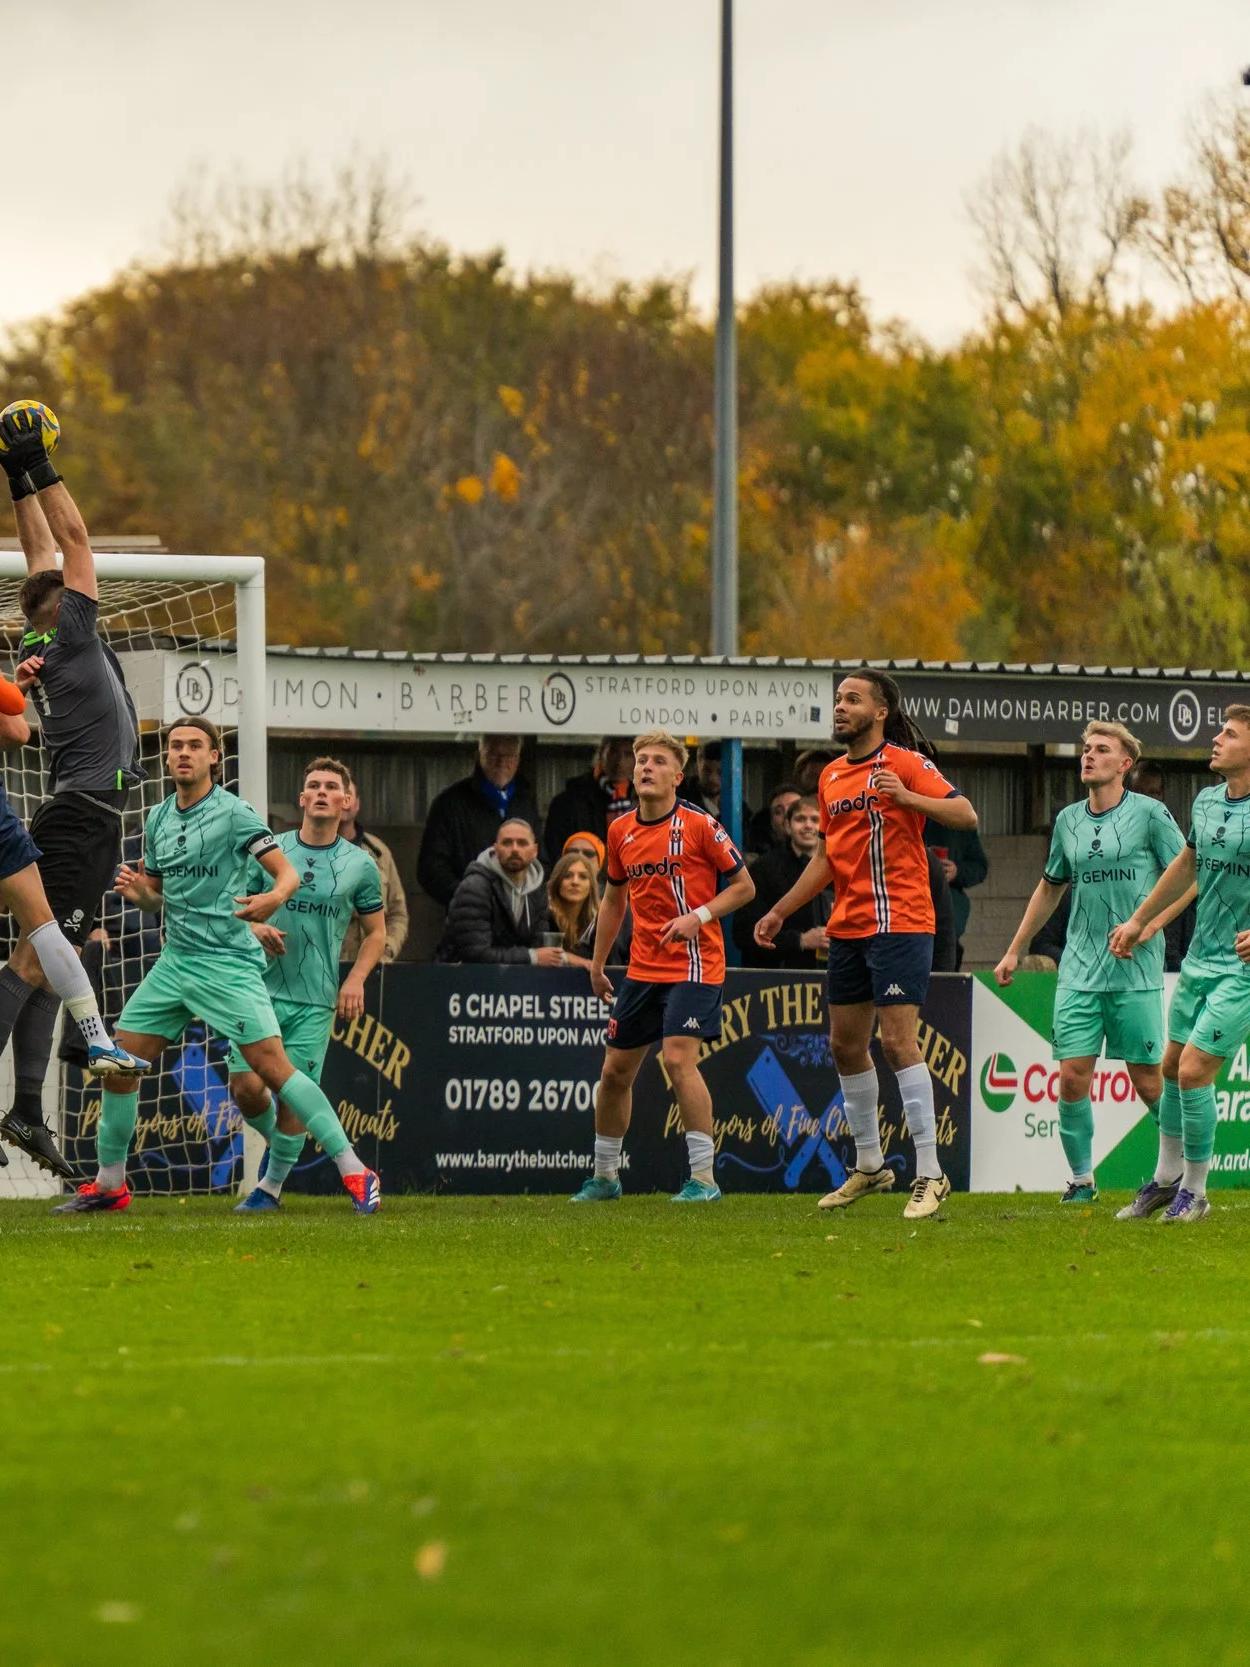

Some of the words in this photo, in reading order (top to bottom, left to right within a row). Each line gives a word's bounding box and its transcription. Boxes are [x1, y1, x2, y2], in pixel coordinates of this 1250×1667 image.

[224, 677, 358, 710] DIMON
[401, 682, 533, 713] BARBER
[585, 676, 695, 695] STRATFORD
[706, 679, 759, 697] UPON
[768, 680, 819, 699] AVON
[619, 708, 699, 725] LONDON
[729, 709, 784, 727] PARIS
[903, 697, 1159, 724] WW.DAIMONBARBER.COM
[168, 865, 218, 878] GEMINI
[1082, 868, 1136, 884] GEMINI
[286, 898, 340, 918] GEMINI
[448, 993, 461, 1017] 6
[466, 993, 545, 1019] CHAPEL
[760, 982, 823, 1031] THE
[449, 1026, 534, 1045] STRATFORD
[538, 1027, 578, 1046] UPON
[582, 1028, 608, 1046] AVO
[445, 1078, 520, 1111] 01789
[528, 1079, 599, 1111] 2670
[186, 1101, 211, 1143] of
[338, 1099, 400, 1142] Meats
[762, 1103, 783, 1147] of
[787, 1104, 821, 1140] Fine
